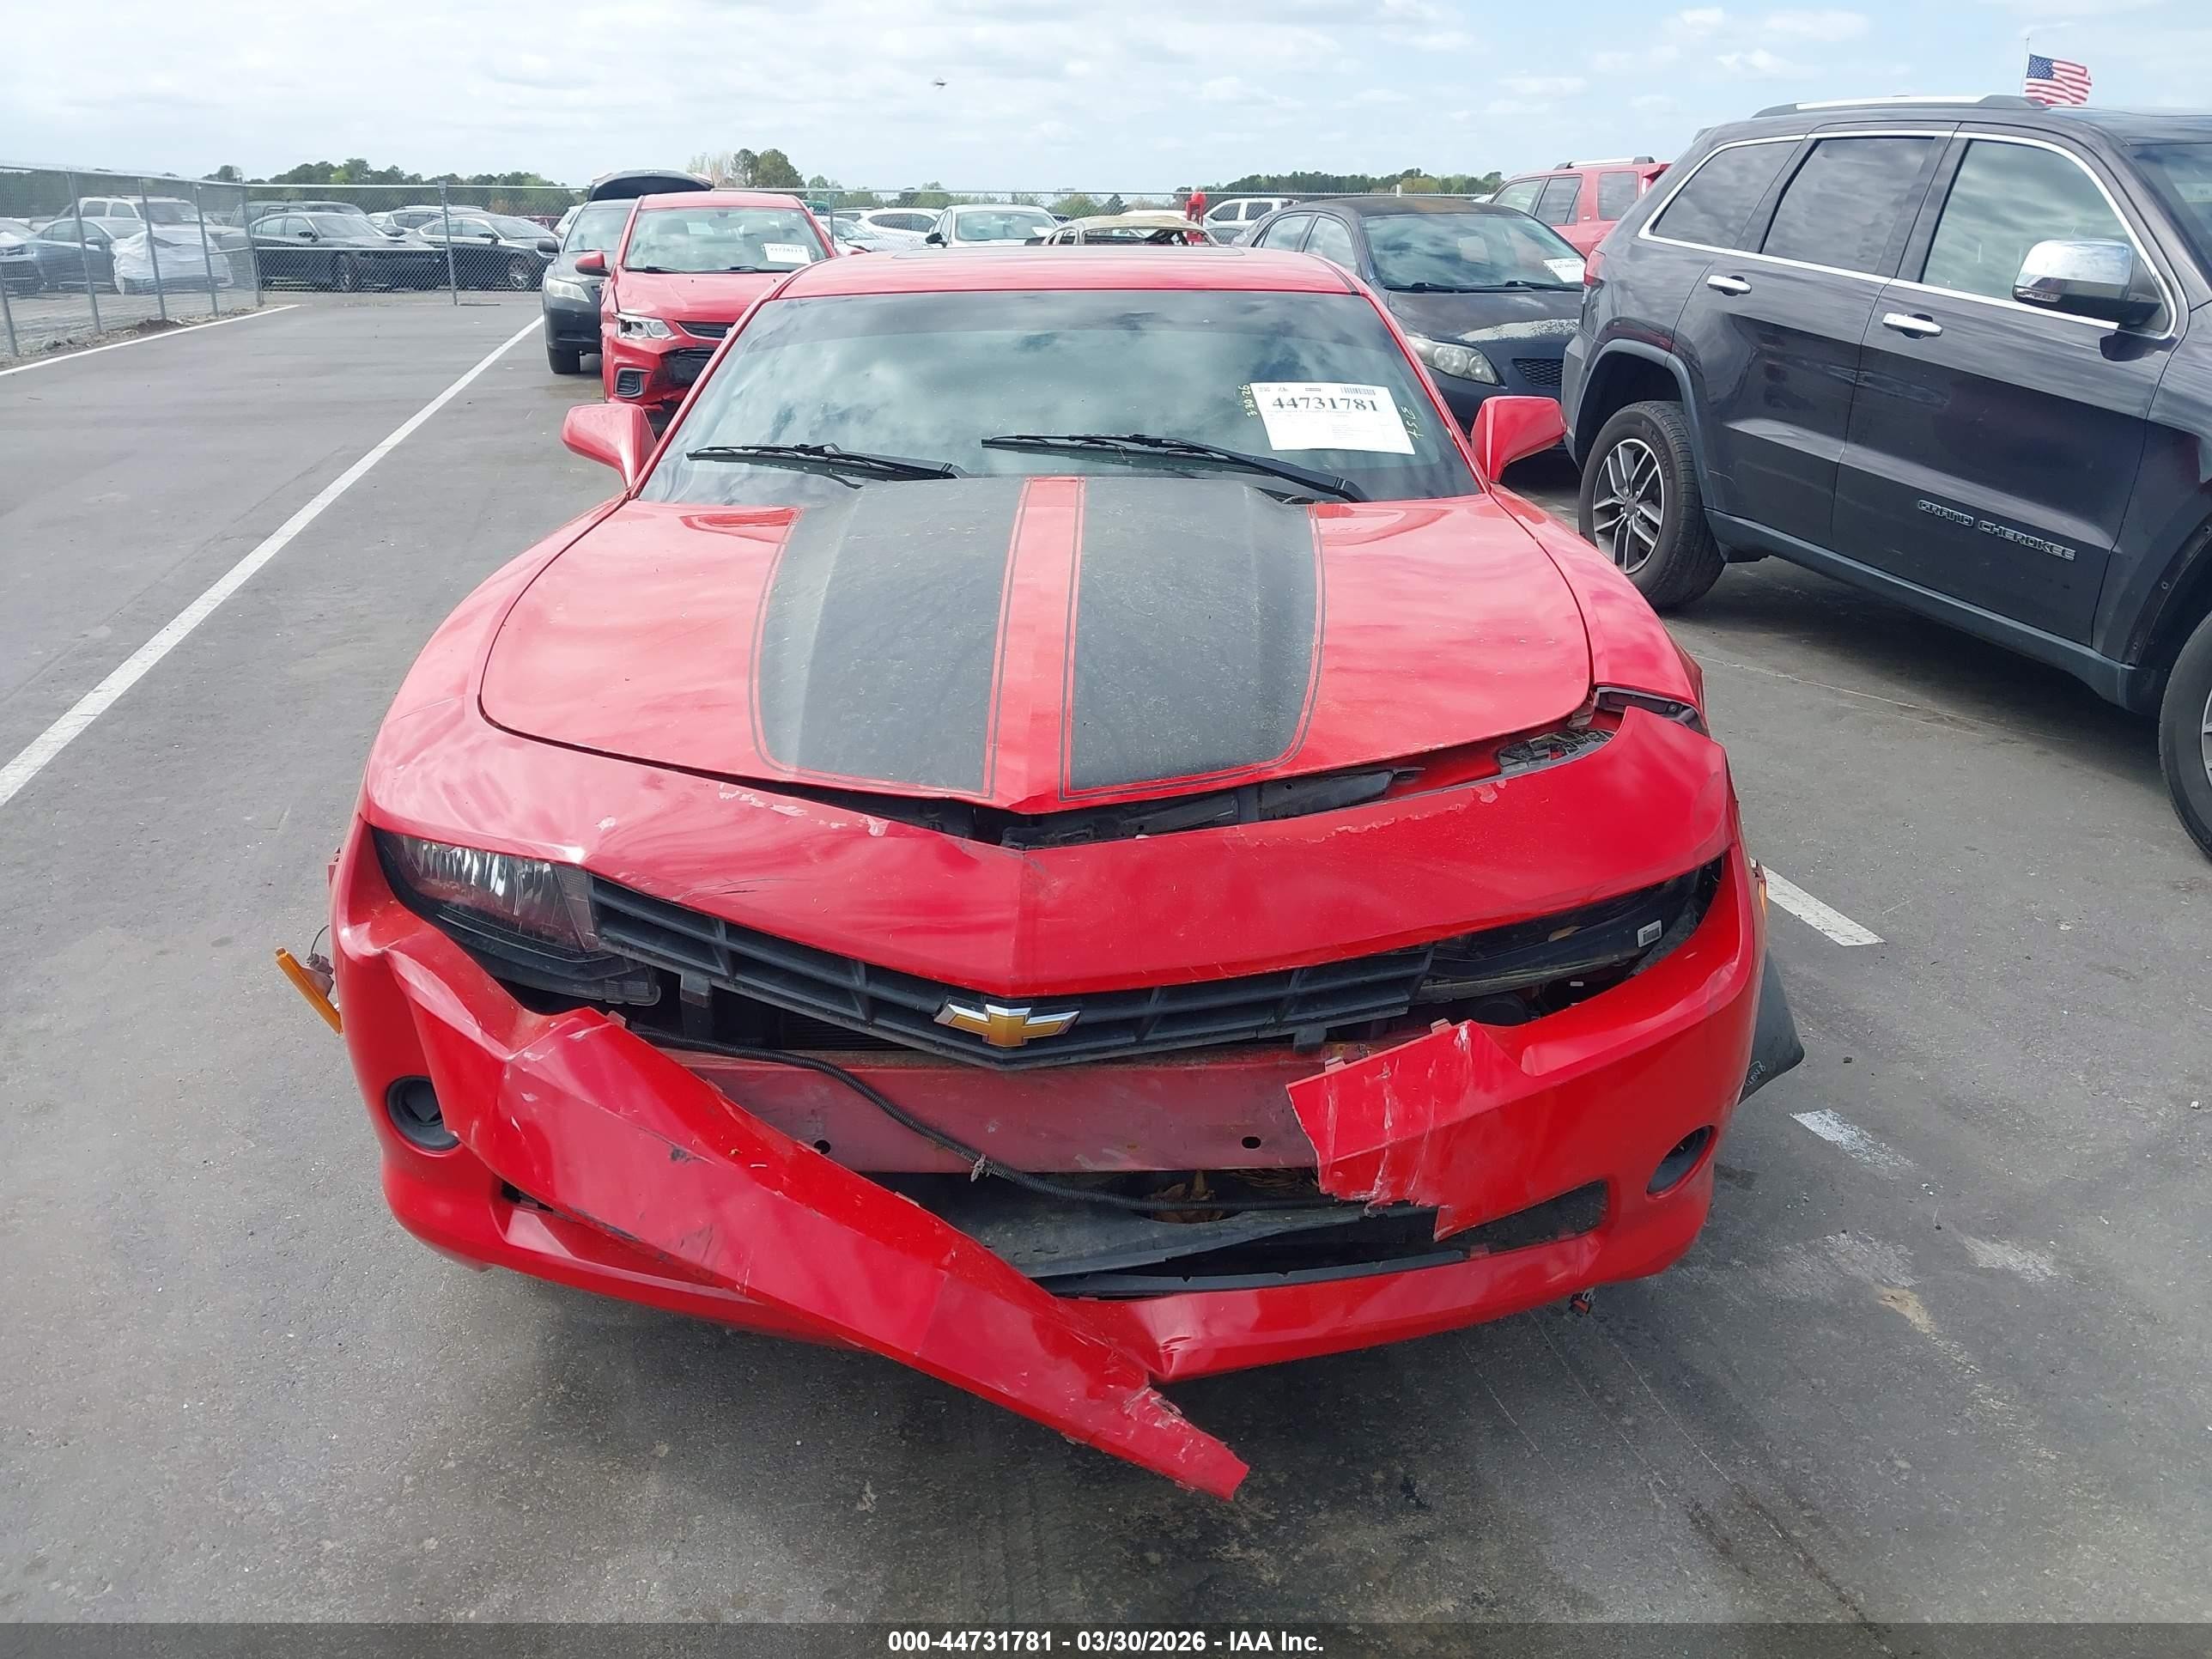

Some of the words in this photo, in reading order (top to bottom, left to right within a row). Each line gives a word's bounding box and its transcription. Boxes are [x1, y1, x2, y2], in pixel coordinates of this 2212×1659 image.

[1273, 397, 1379, 412] 44731781
[1917, 499, 1974, 527] GRAND
[1978, 520, 2077, 562] CHEROKEE
